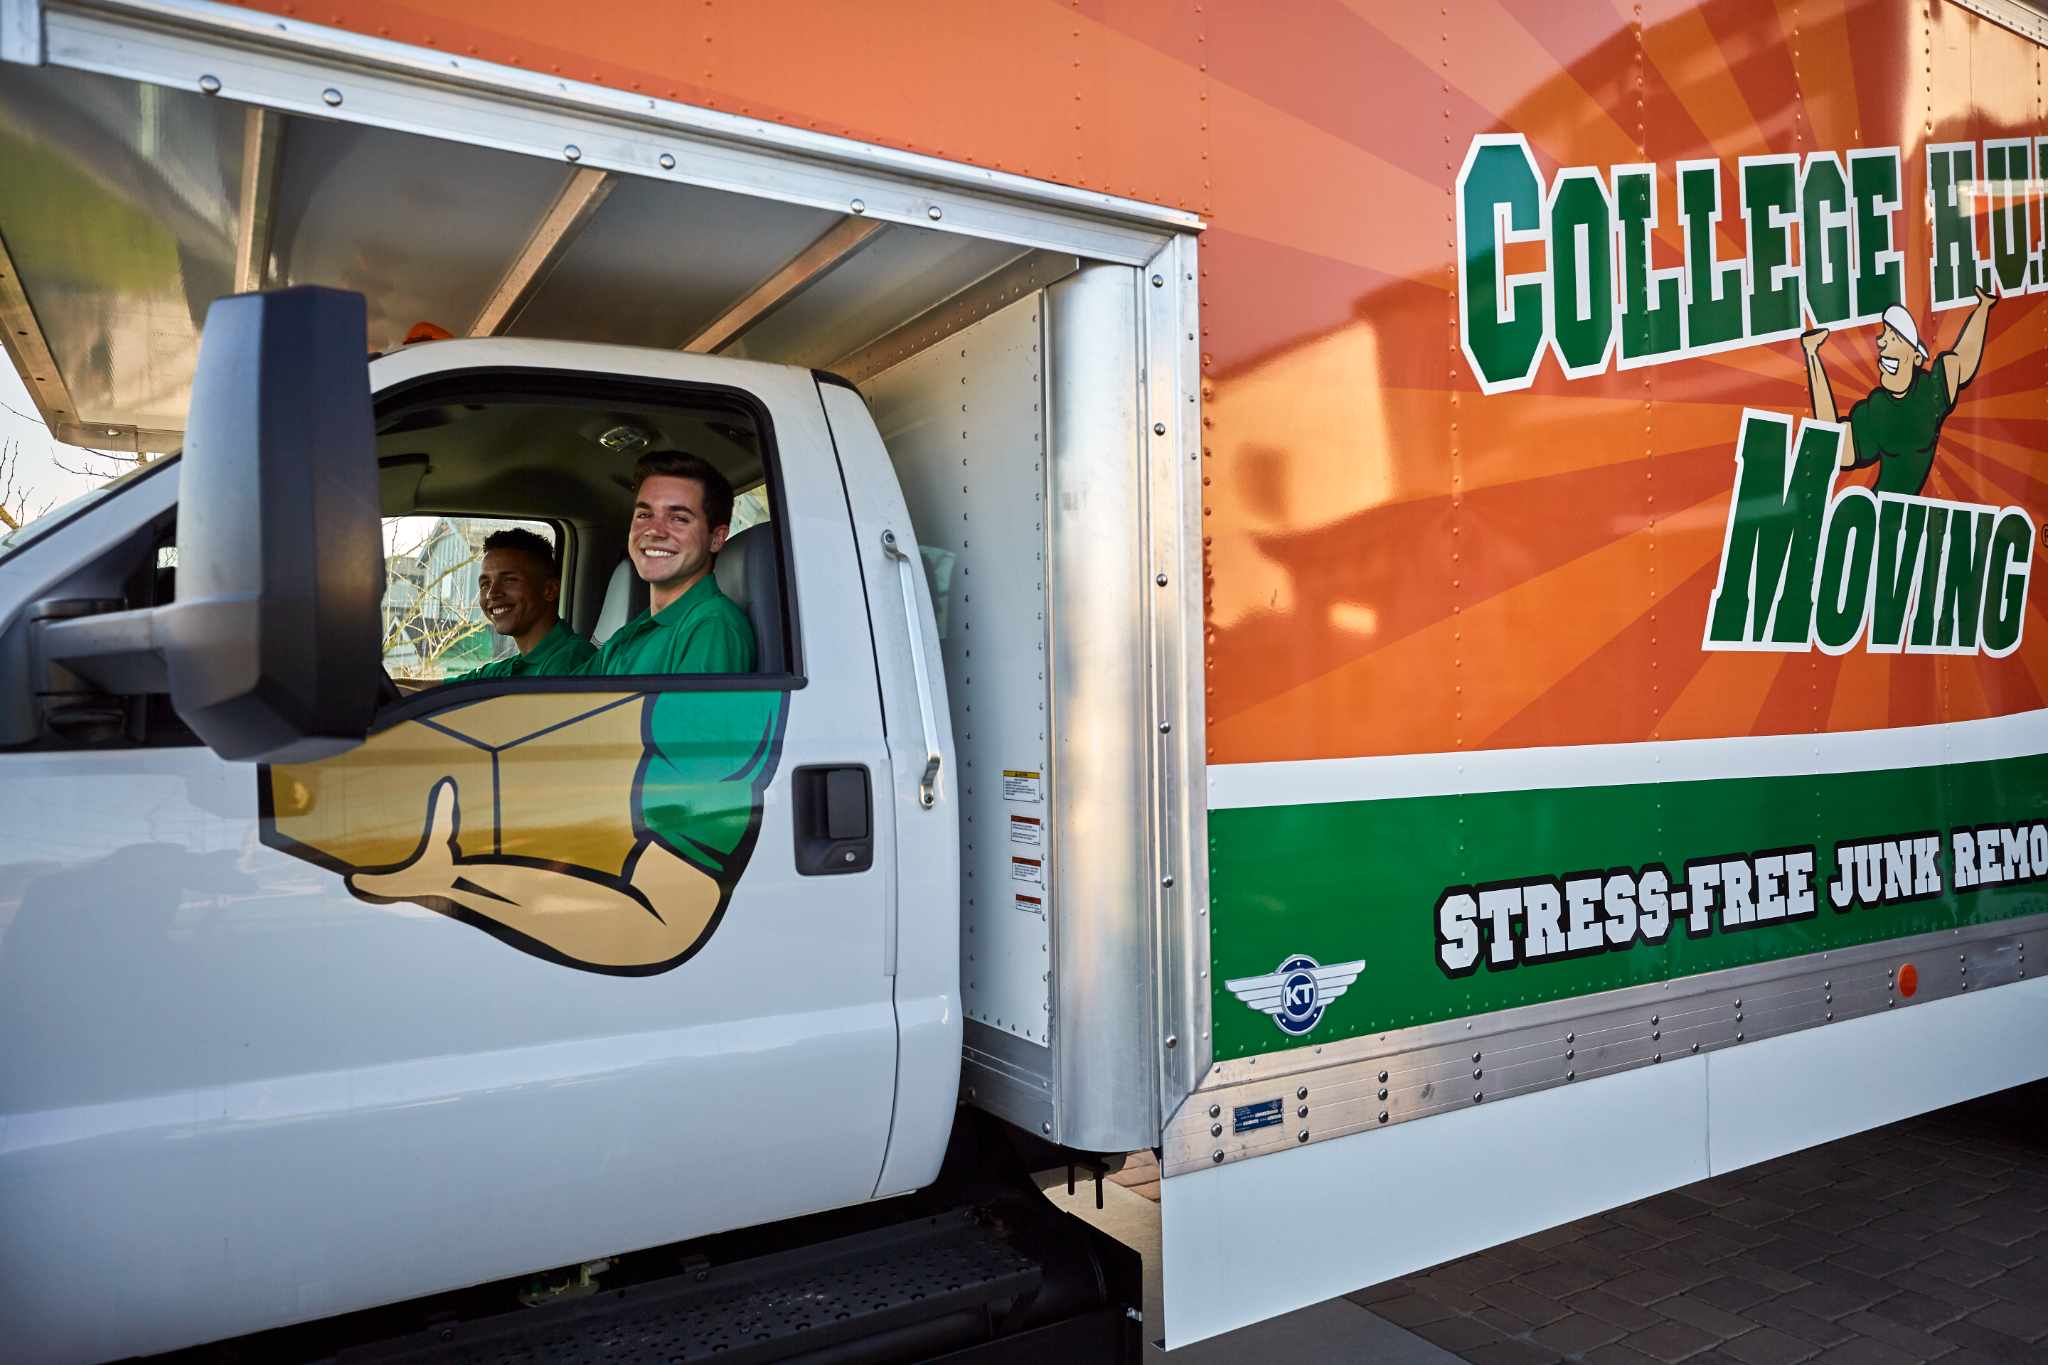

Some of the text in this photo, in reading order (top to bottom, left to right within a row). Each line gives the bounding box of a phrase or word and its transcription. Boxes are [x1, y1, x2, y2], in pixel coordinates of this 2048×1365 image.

[1456, 133, 2048, 394] COLLEGE H.U.
[1702, 407, 2036, 658] MOVING
[1285, 983, 1314, 1007] KT
[1439, 851, 1816, 970] STRESS-FREE
[1830, 836, 1942, 908] JUNK
